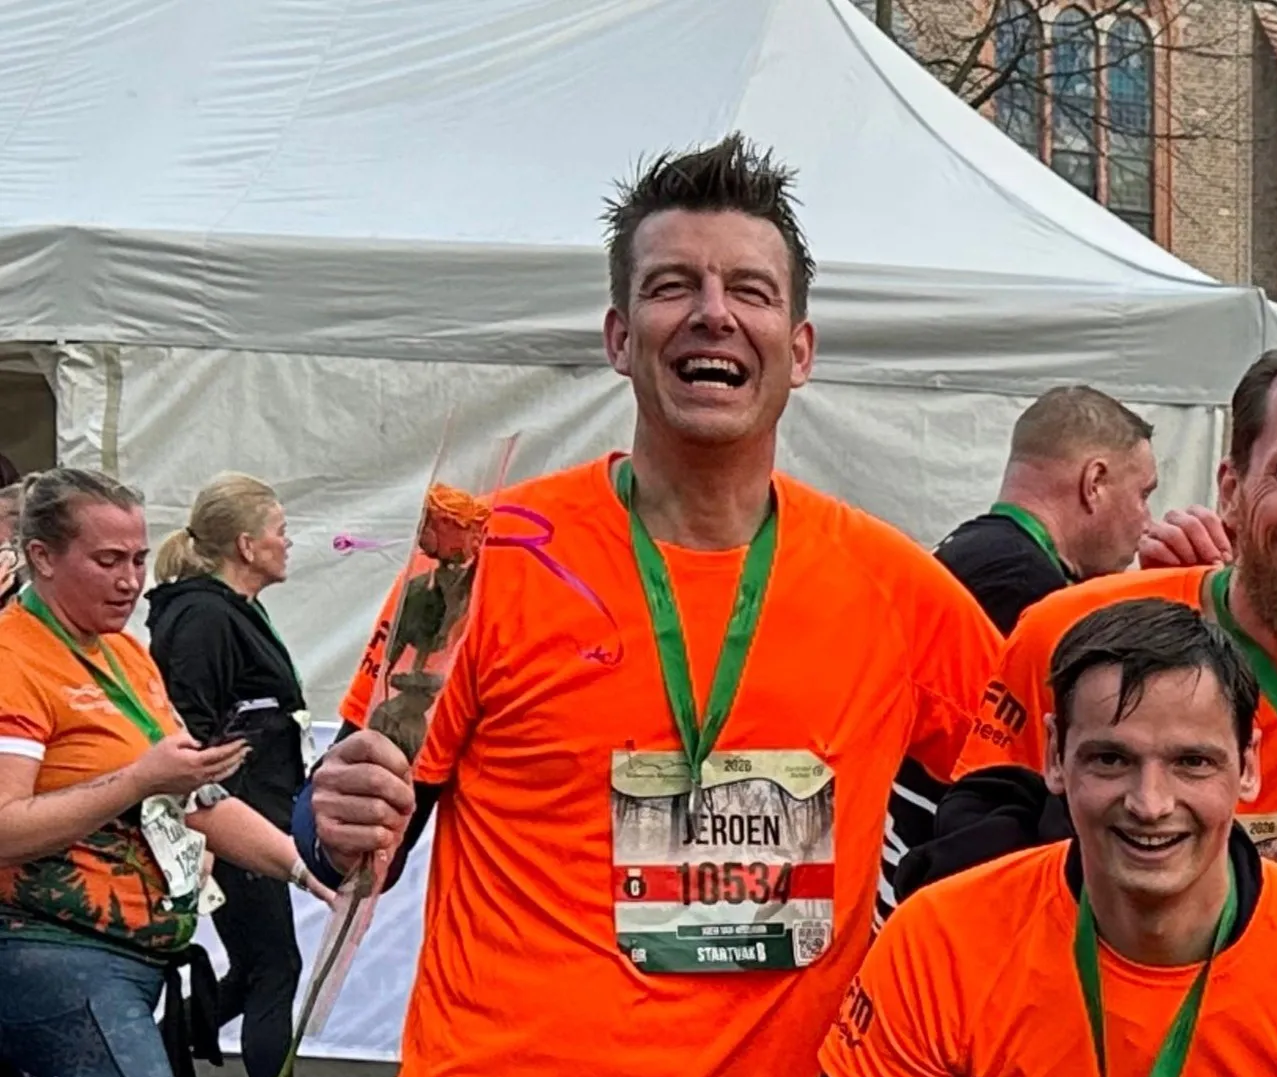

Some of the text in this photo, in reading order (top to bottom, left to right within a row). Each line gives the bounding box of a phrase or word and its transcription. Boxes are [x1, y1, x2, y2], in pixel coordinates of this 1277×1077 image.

[682, 814, 781, 846] JEROEN
[677, 861, 793, 906] 10534
[697, 942, 766, 963] STARTVAK B
